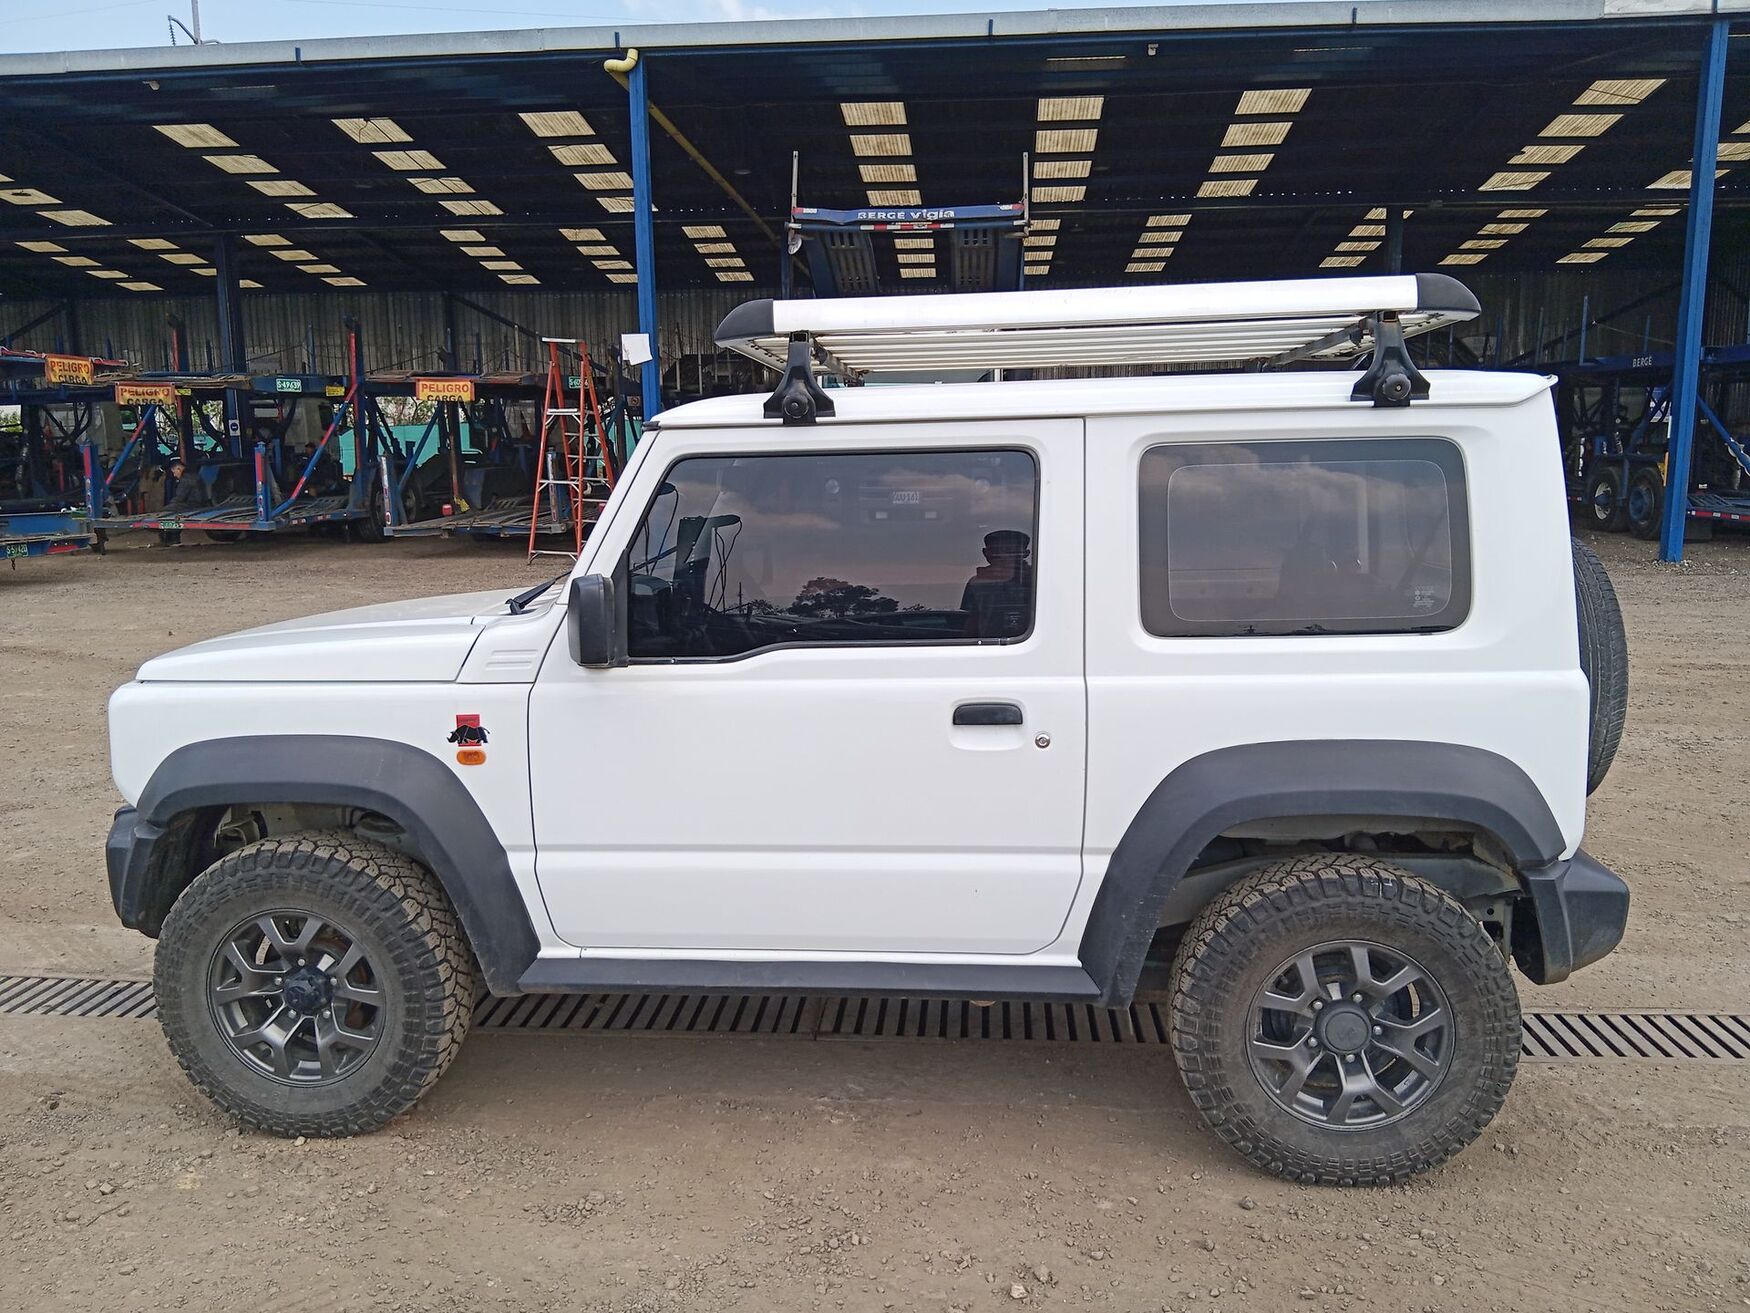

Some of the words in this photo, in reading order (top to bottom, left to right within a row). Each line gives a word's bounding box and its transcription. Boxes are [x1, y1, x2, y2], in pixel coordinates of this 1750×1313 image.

[50, 360, 90, 375] PELIGRO
[120, 387, 170, 397] PELIGRO
[421, 383, 470, 393] PELIGRO
